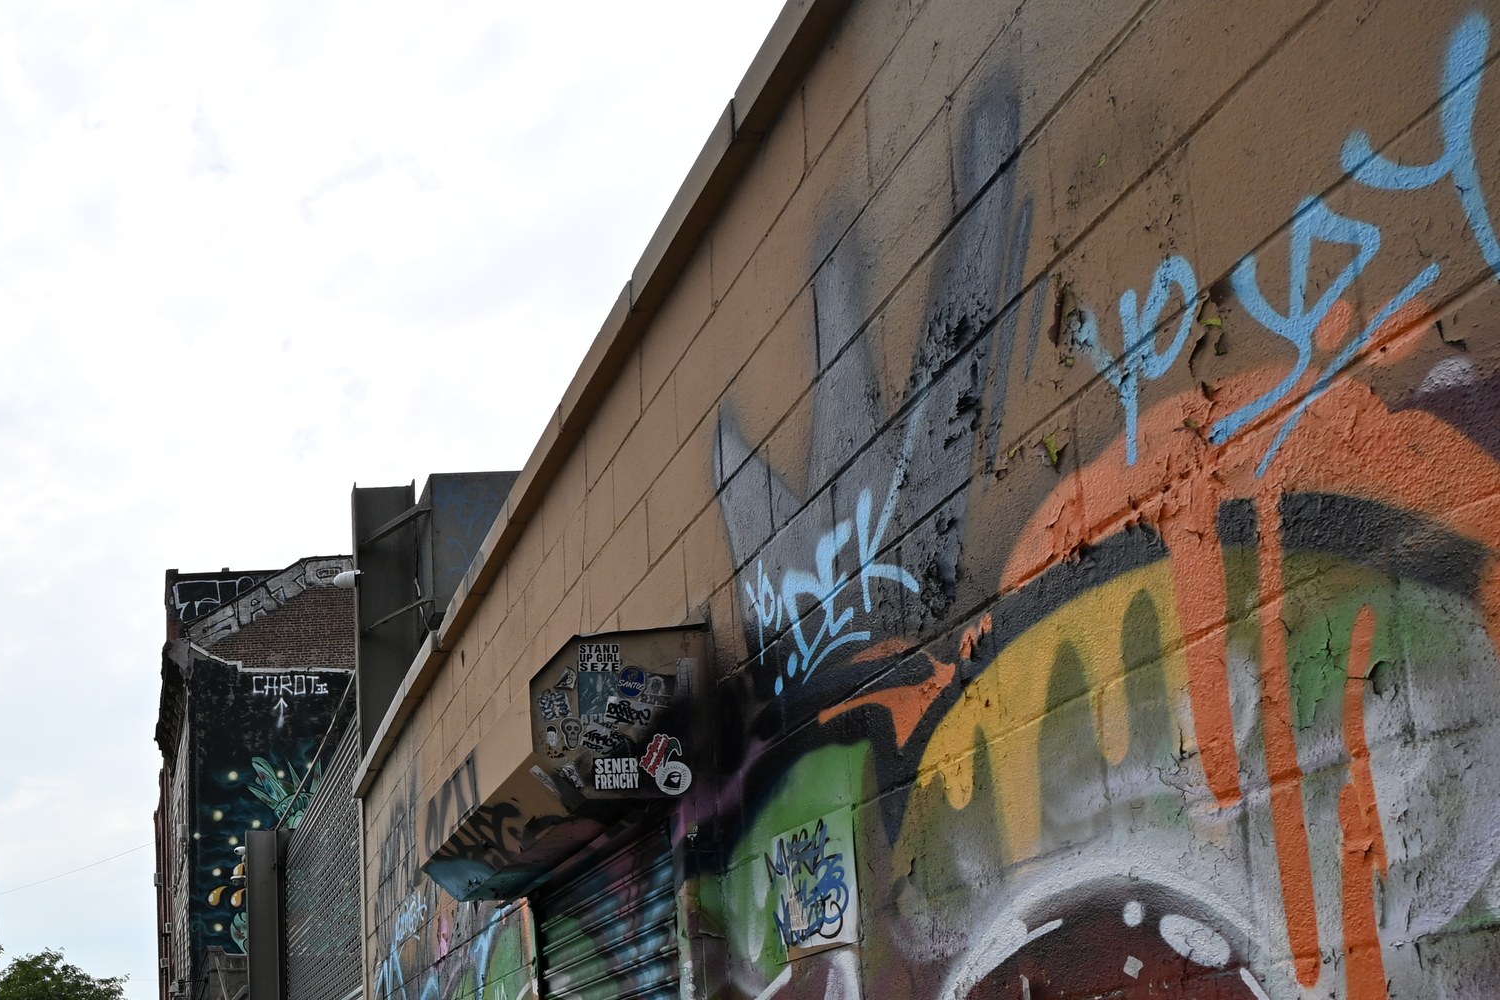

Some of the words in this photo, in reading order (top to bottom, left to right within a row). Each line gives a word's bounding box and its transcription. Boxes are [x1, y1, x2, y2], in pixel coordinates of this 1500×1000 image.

[580, 645, 619, 654] STAND
[580, 653, 593, 662] UP
[596, 653, 619, 662] GIRL
[580, 663, 619, 672] SEZE
[594, 757, 639, 775] SENER
[594, 773, 640, 790] FRENCHY
